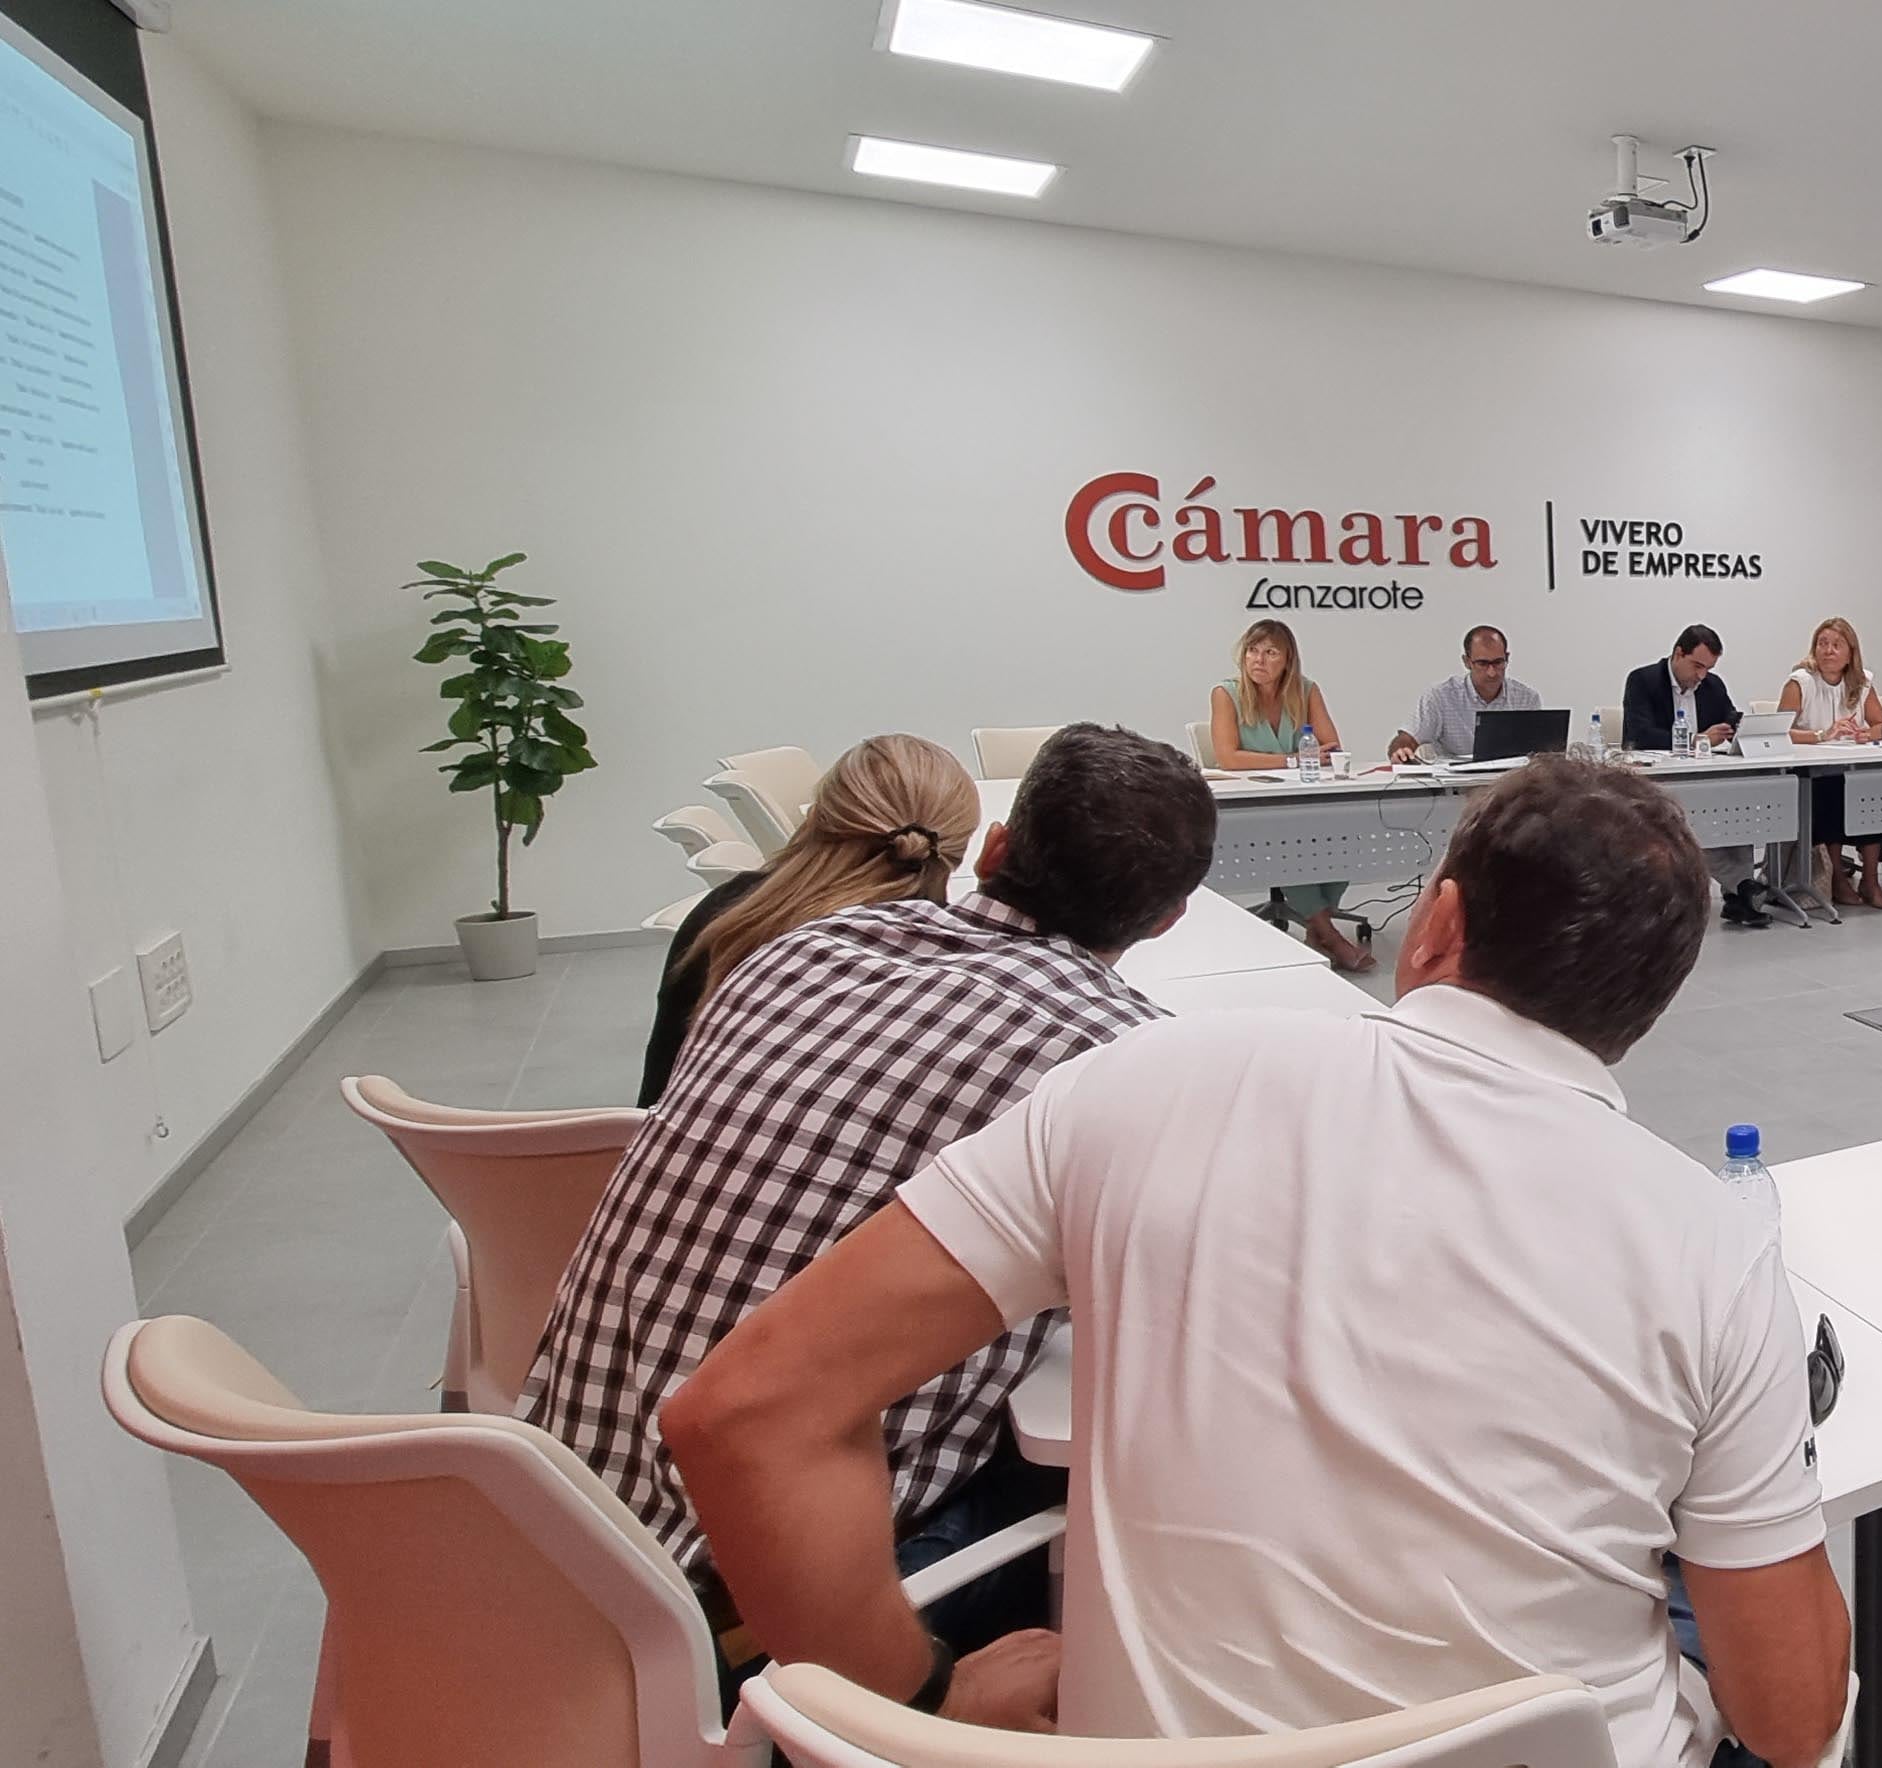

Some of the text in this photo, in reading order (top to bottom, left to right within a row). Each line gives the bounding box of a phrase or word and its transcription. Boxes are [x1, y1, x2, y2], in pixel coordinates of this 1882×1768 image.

[1580, 519, 1684, 548] VIVERO
[1582, 550, 1763, 579] DE EMPRESAS
[1246, 577, 1425, 611] Lanzarote
